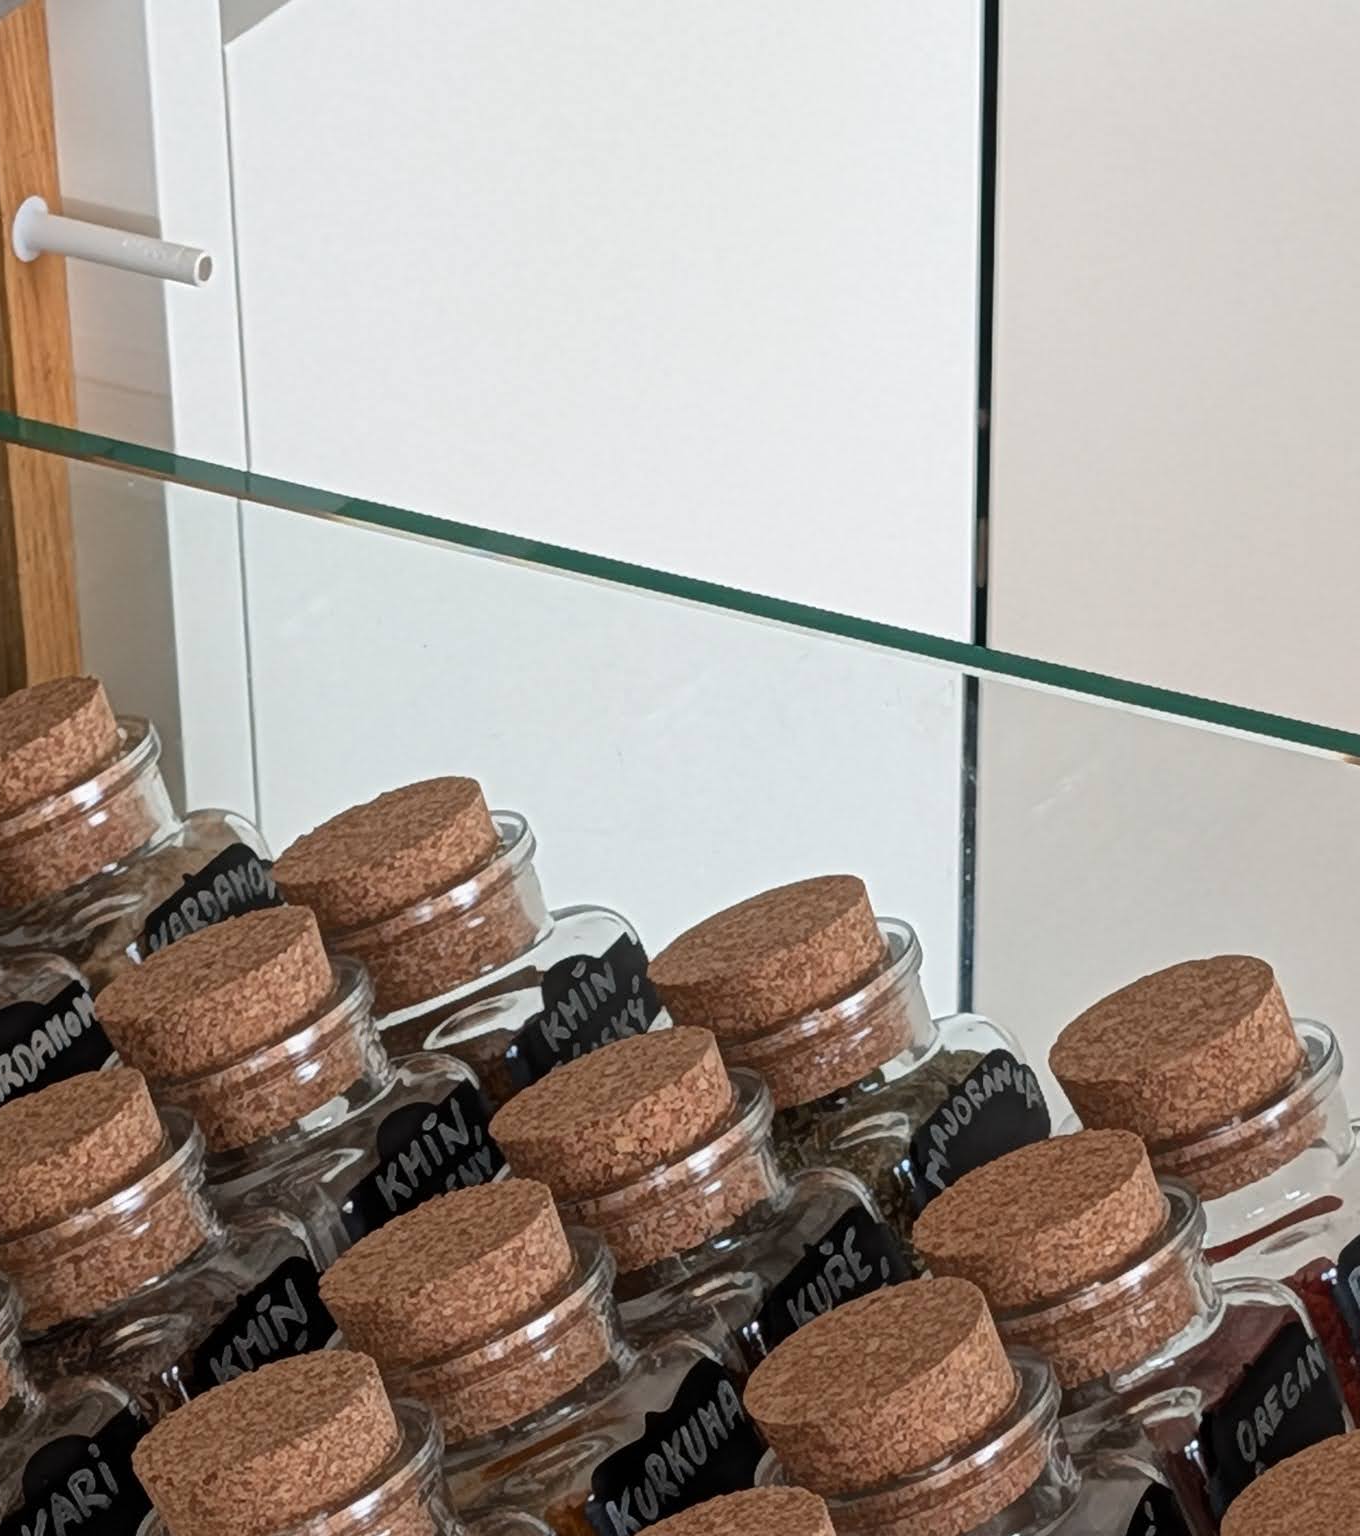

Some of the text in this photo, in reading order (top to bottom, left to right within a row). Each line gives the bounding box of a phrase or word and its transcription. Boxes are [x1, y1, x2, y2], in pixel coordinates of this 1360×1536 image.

[541, 960, 616, 1051] KMÍN
[376, 1098, 469, 1211] KMÍN
[210, 1278, 307, 1385] KMÍN
